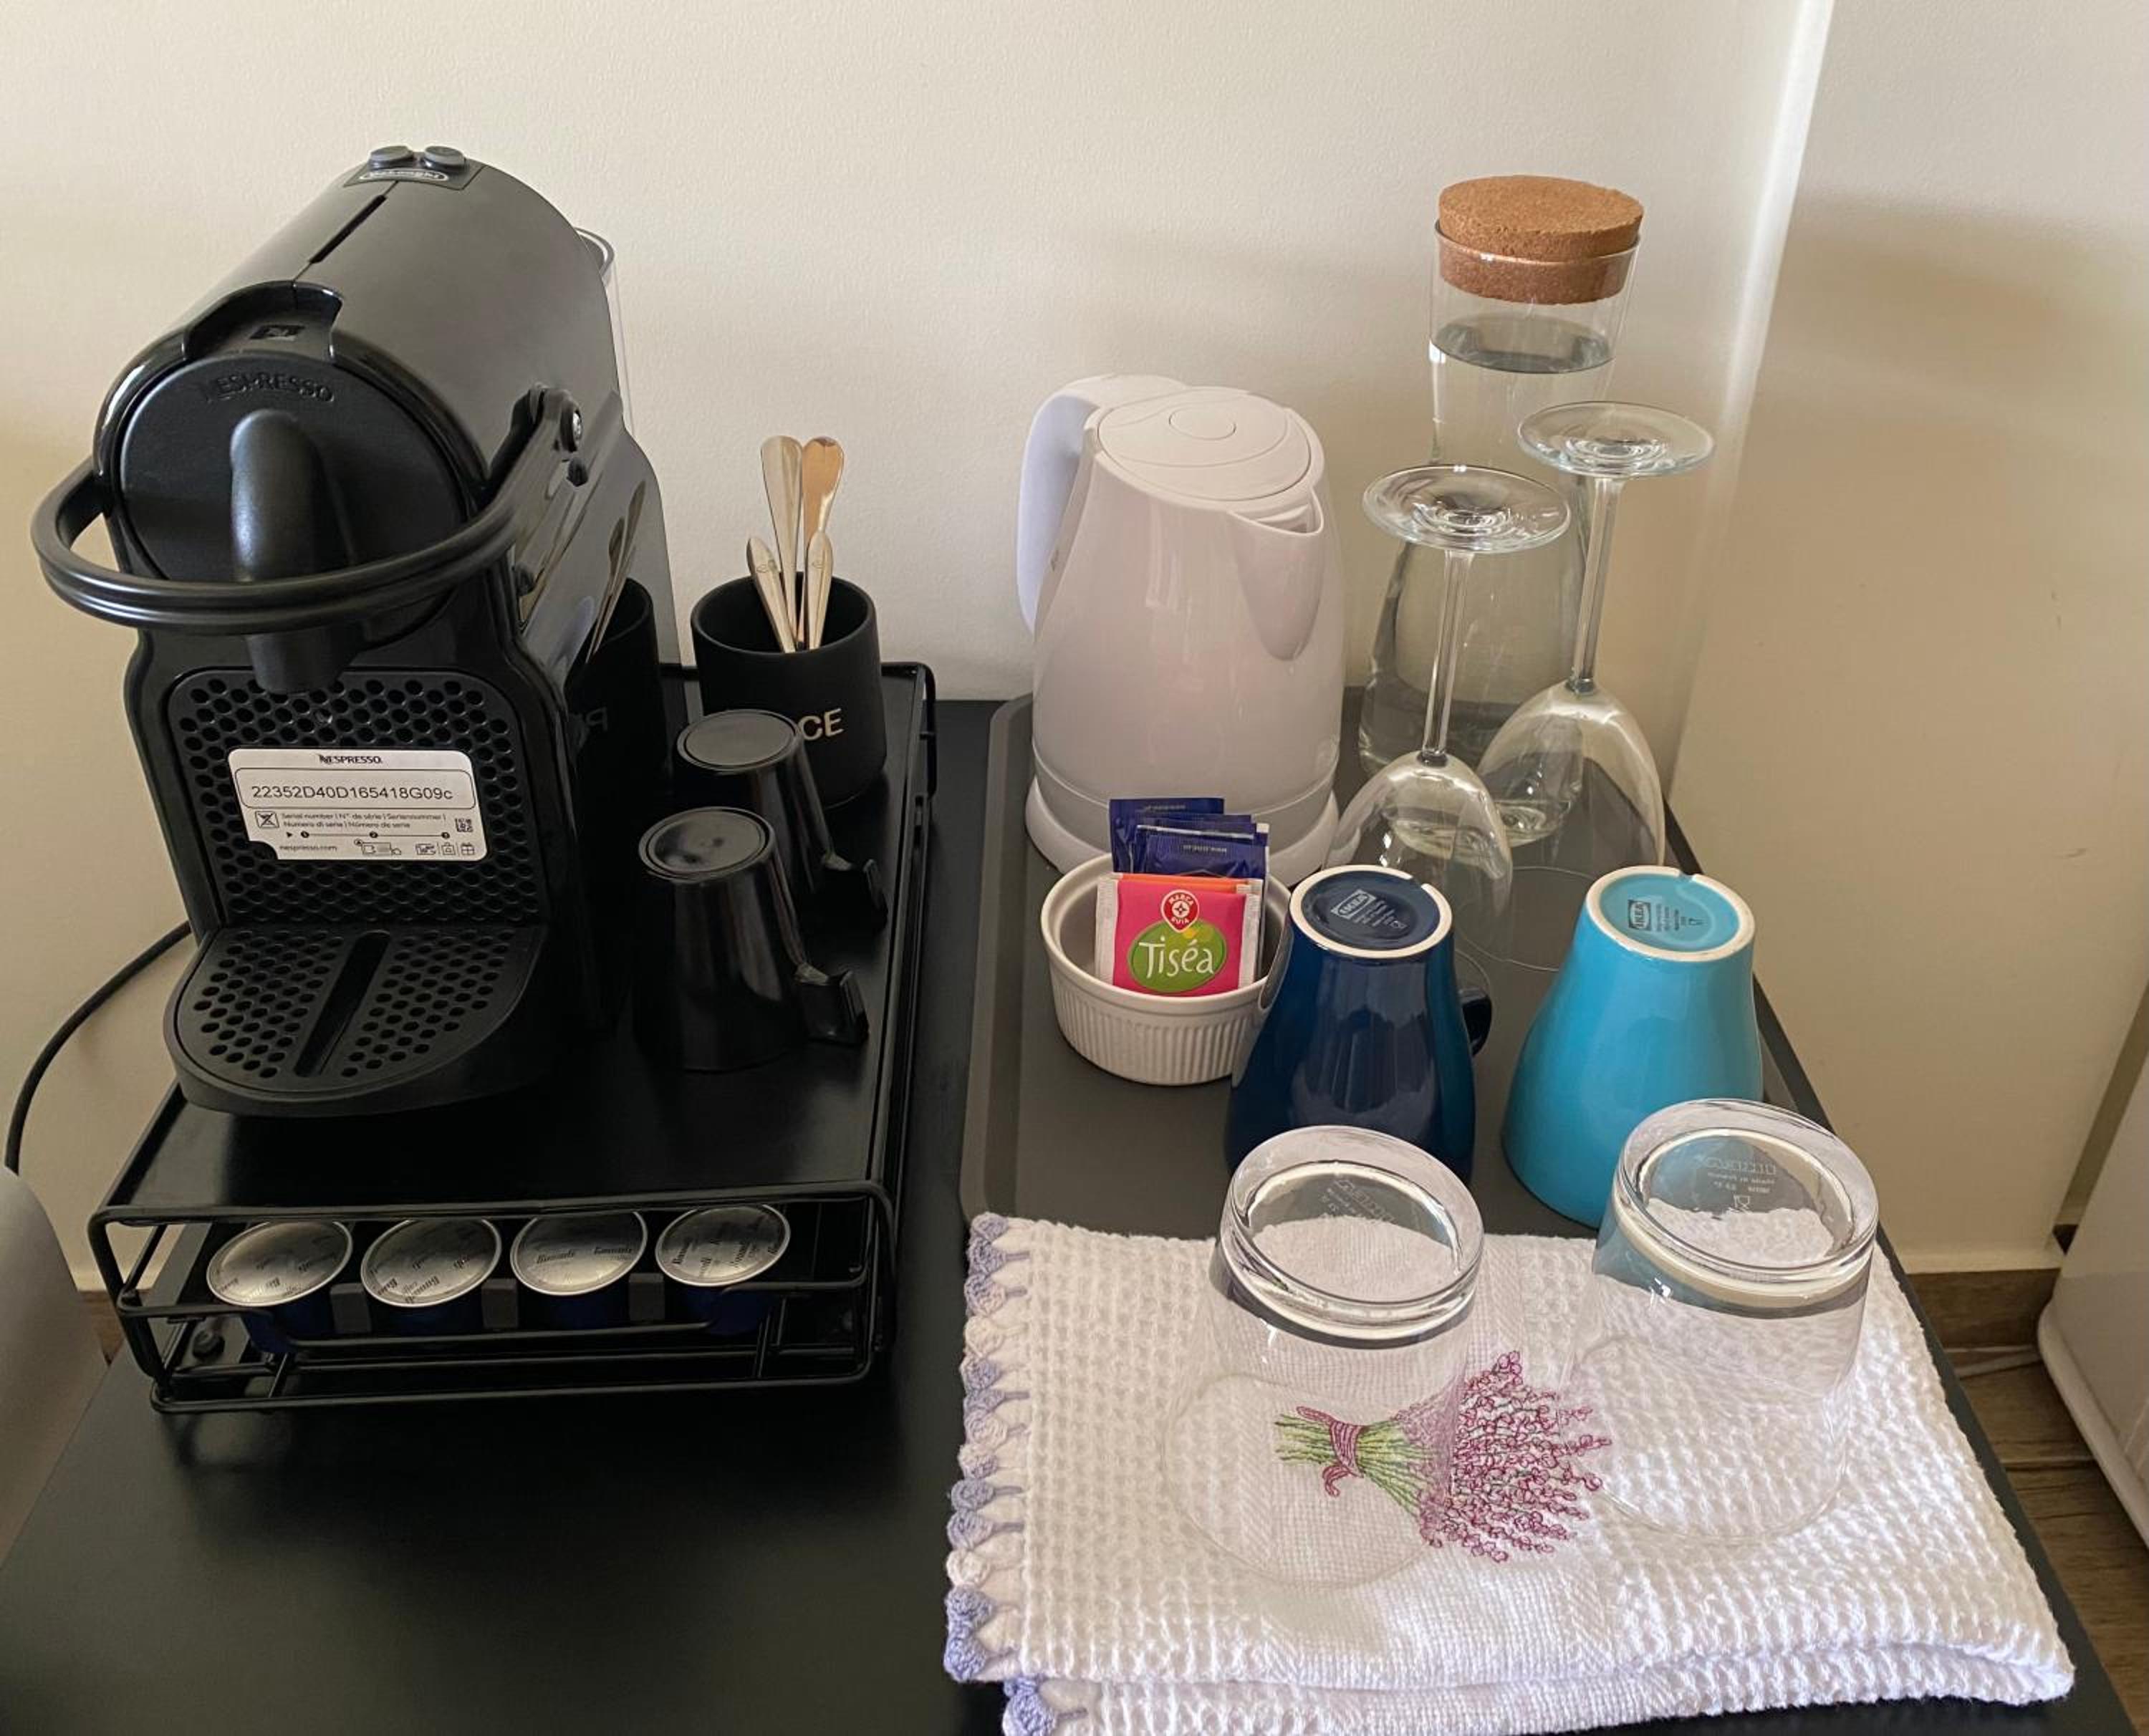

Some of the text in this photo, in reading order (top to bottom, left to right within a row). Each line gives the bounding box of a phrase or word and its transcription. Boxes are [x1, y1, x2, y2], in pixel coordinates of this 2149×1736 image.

[797, 708, 844, 741] CE
[251, 785, 453, 800] 22352D40D165418G09c
[1138, 935, 1214, 978] Tiséa
